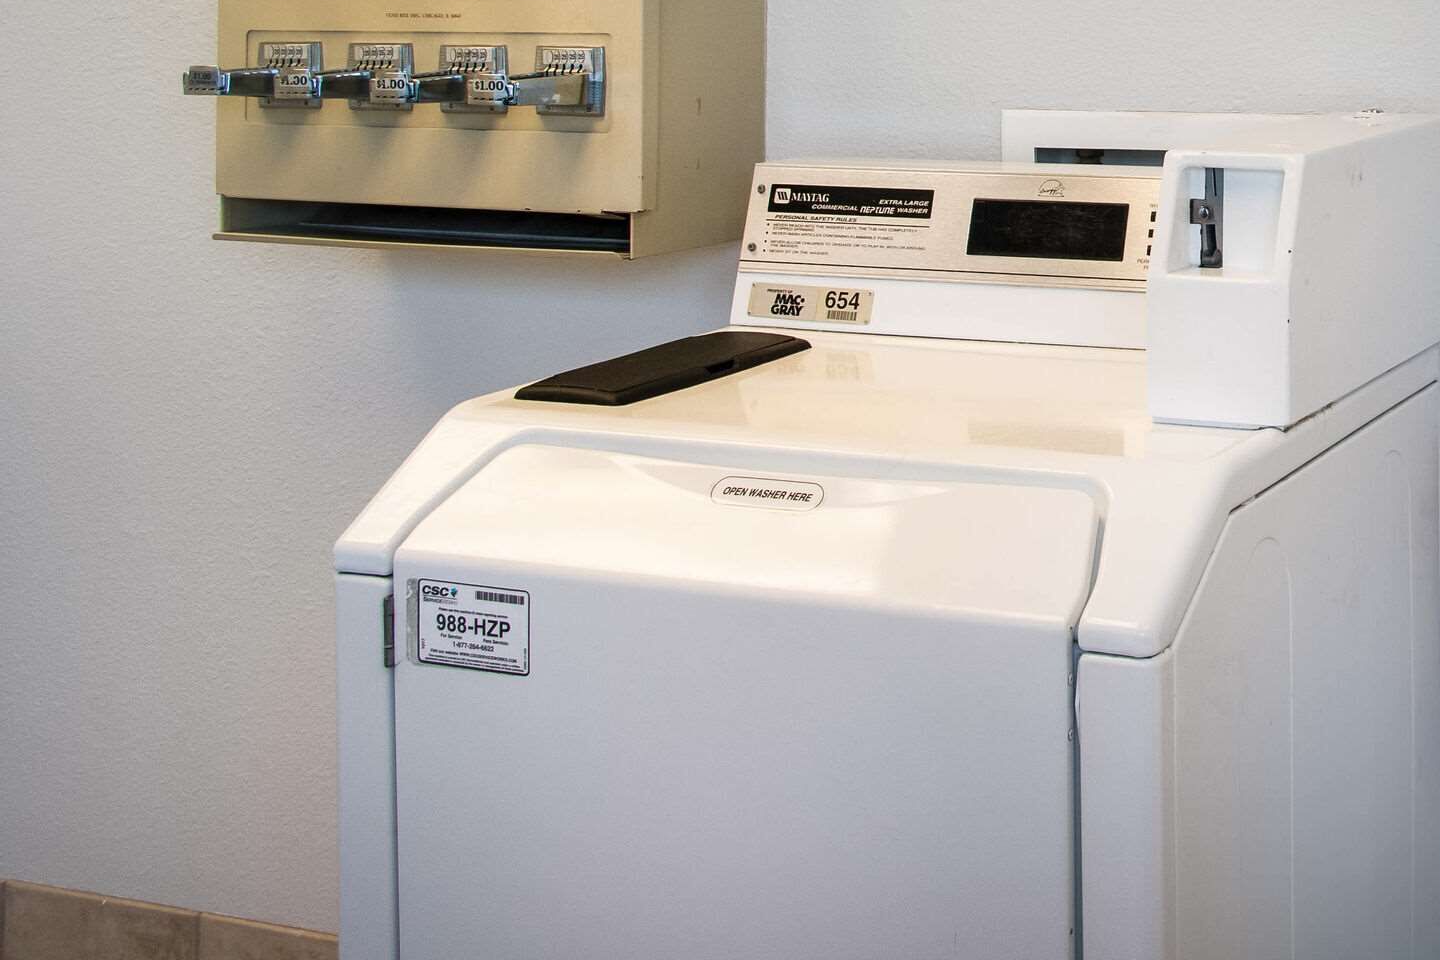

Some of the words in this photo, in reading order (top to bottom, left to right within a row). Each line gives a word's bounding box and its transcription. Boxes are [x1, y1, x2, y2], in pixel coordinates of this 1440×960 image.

[376, 79, 405, 89] $1.00
[474, 80, 504, 91] $1.00
[791, 192, 830, 202] MAYTAG
[825, 291, 860, 310] 654
[771, 305, 804, 316] GRAY
[722, 486, 749, 497] OPEN
[749, 488, 787, 500] WASHER
[787, 492, 814, 502] HERE
[422, 585, 449, 596] CSC
[436, 613, 511, 638] 988-HZP
